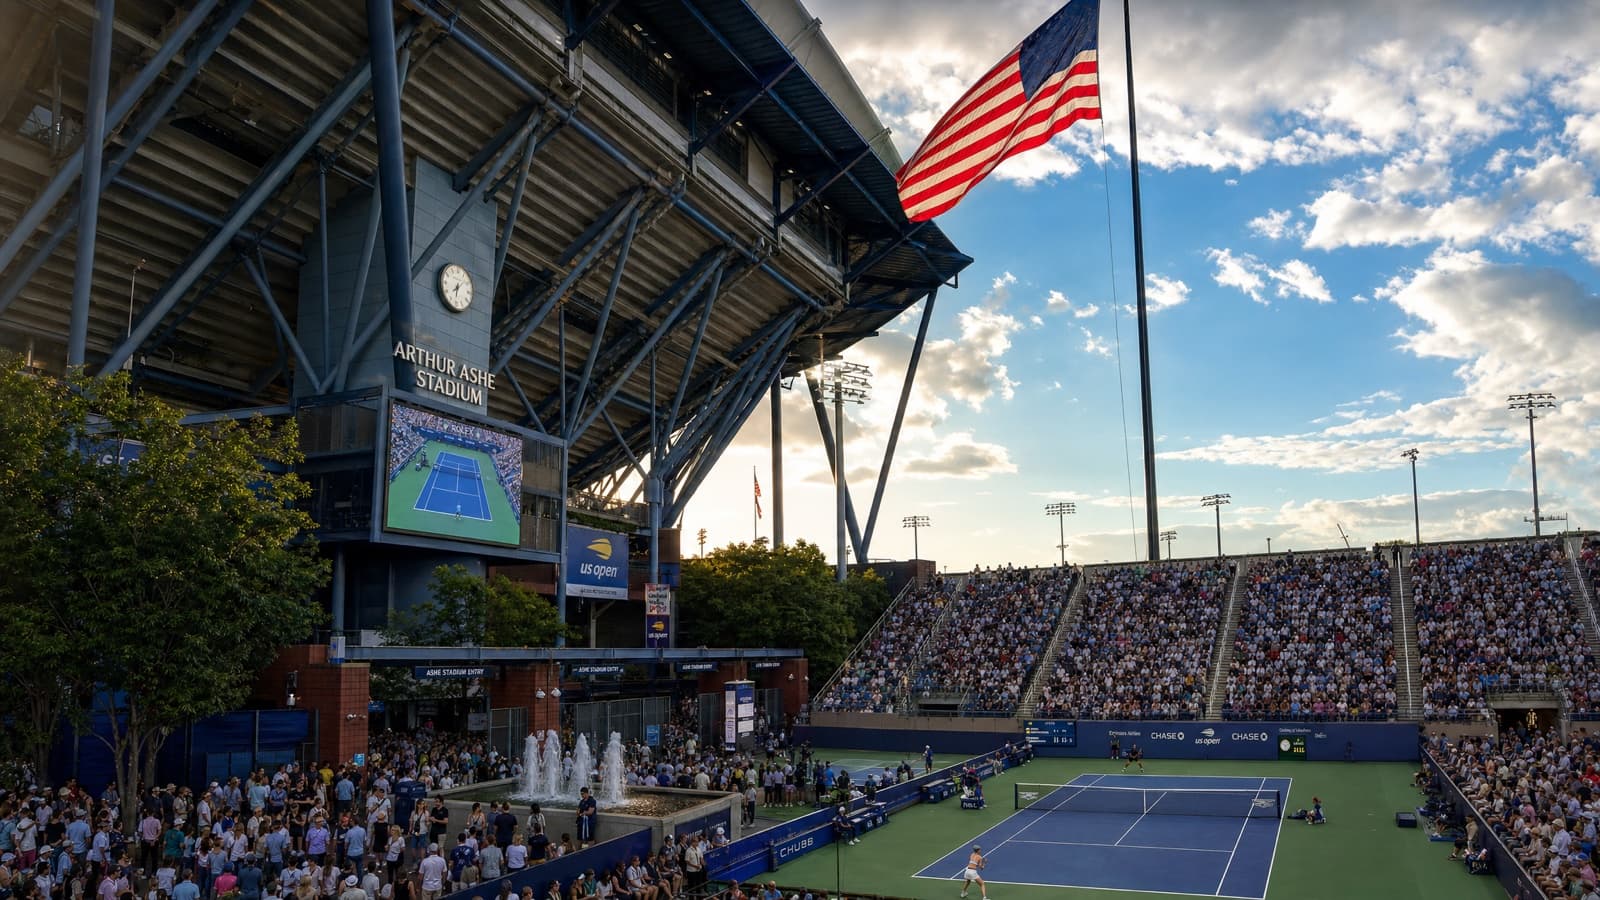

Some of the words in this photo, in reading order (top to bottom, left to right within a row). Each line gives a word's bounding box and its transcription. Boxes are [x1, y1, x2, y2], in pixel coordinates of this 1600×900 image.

[394, 341, 456, 377] ARTHUR
[459, 364, 496, 390] ASHE
[416, 370, 482, 406] STADIUM
[580, 562, 593, 575] us
[593, 564, 618, 580] open
[426, 668, 441, 676] ASHE
[442, 668, 467, 676] STADIUM
[1151, 732, 1177, 741] CHASE
[1203, 737, 1221, 746] open
[1231, 732, 1260, 741] CHASE
[779, 837, 814, 858] CHUBB
